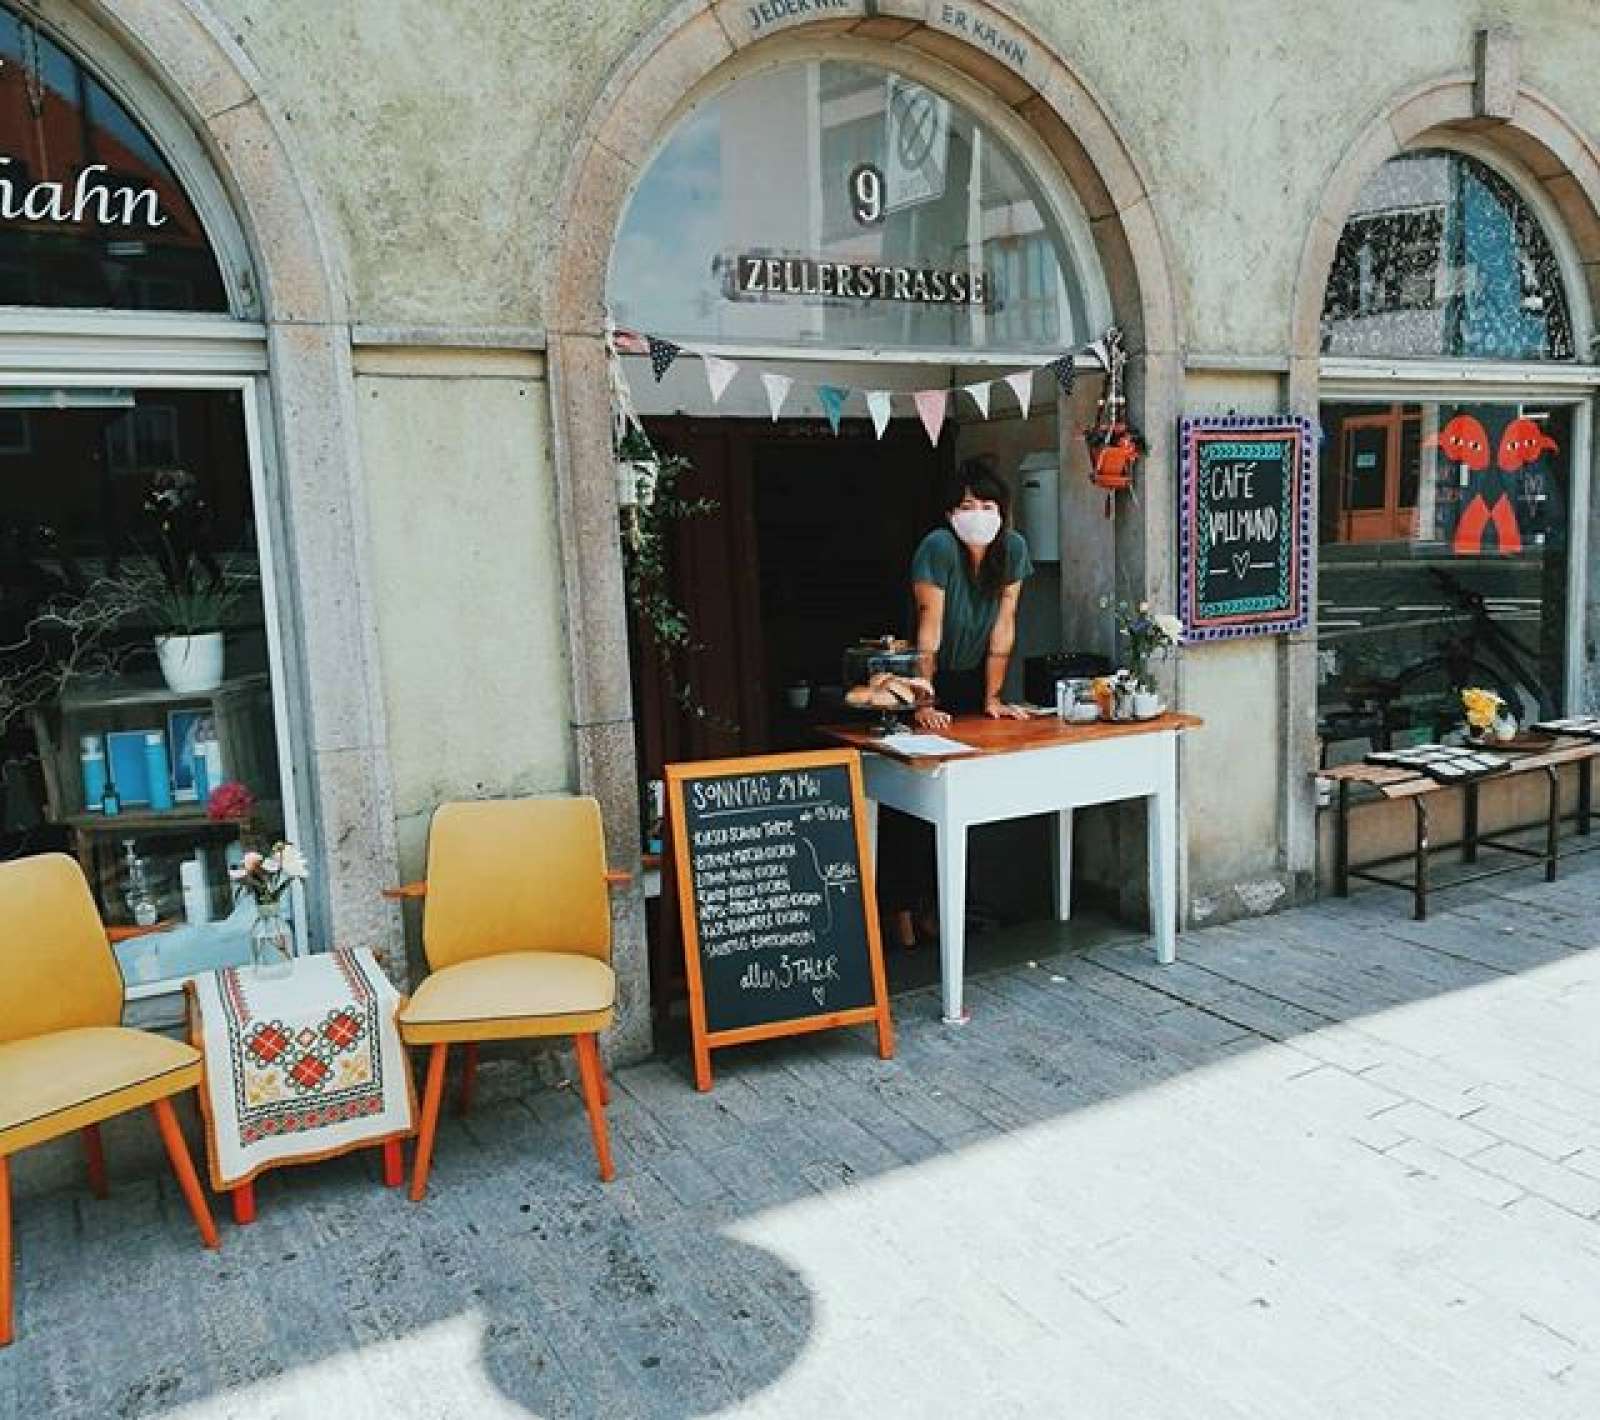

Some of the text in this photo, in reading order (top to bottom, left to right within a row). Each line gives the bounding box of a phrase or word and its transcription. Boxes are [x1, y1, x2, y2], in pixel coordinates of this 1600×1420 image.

[942, 4, 968, 30] ER
[856, 168, 881, 222] 9
[746, 258, 985, 305] ZELLERSTRASSE
[1211, 461, 1258, 501] CAFÉ
[692, 775, 772, 811] SONNTAG
